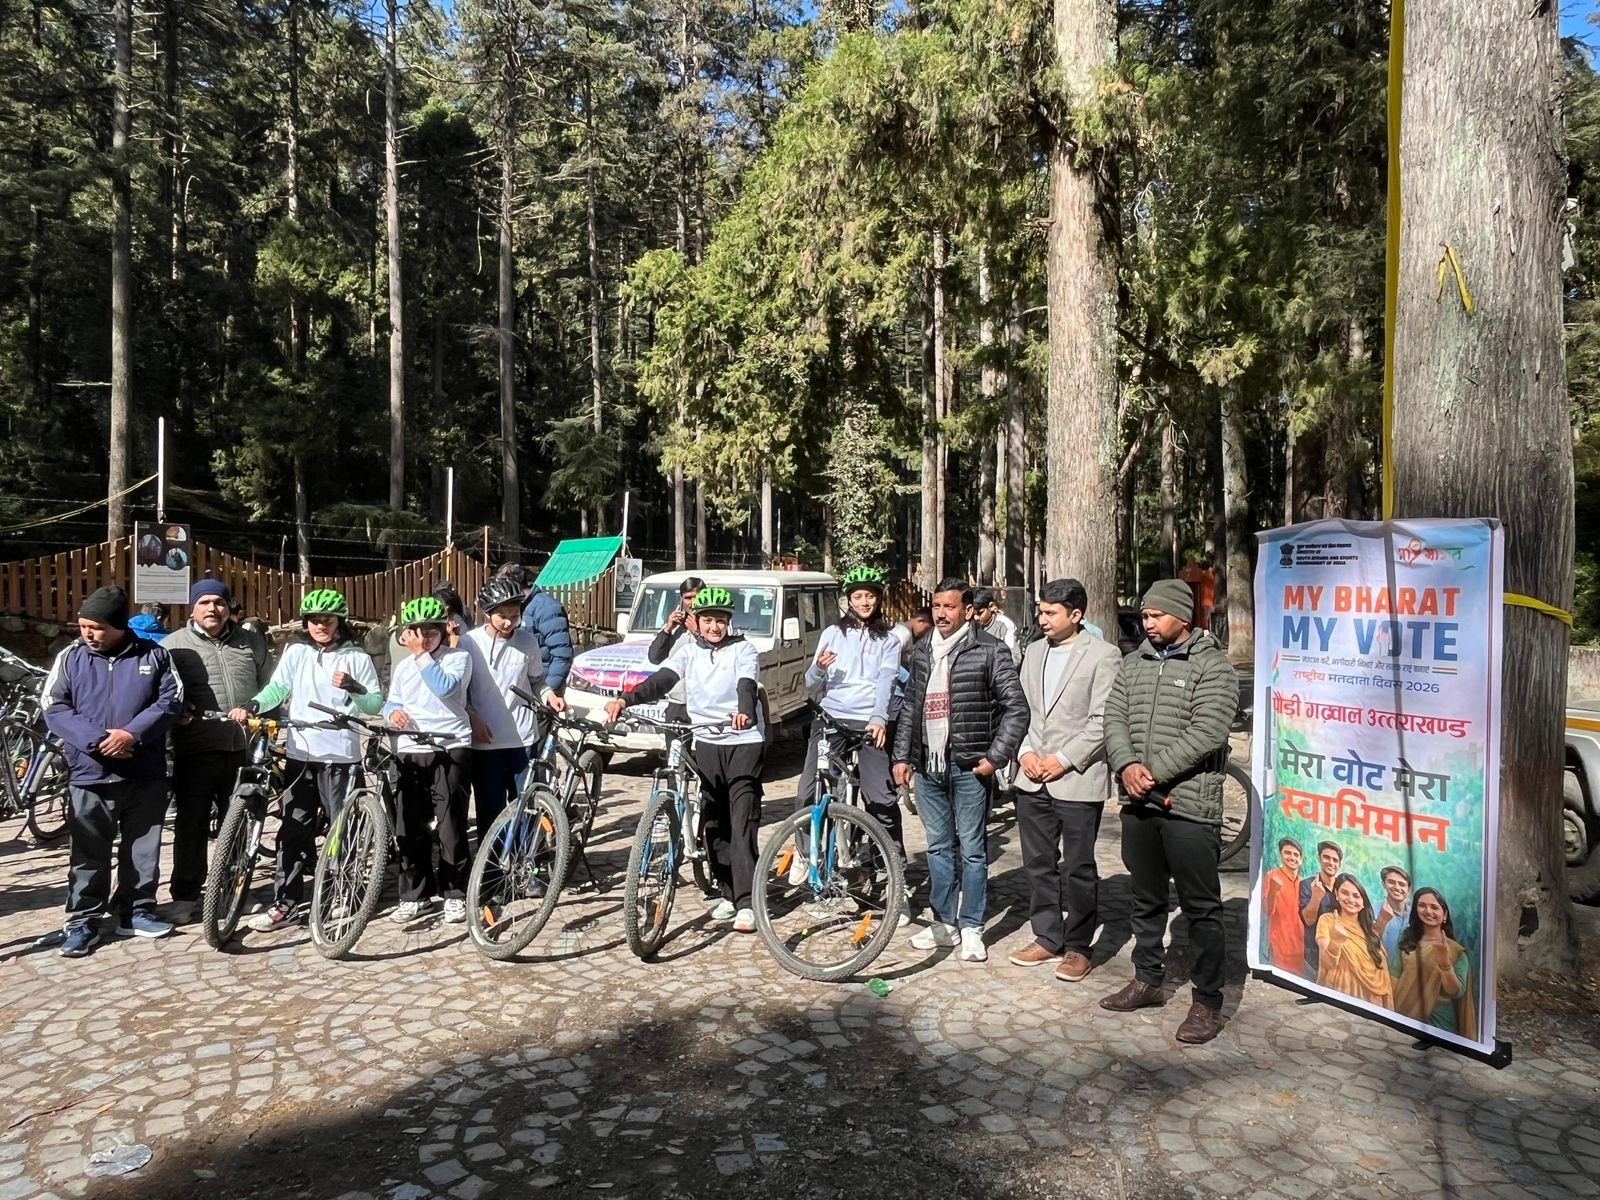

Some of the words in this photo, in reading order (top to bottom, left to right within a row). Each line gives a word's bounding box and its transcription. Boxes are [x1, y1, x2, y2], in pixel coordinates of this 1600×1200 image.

[1283, 585, 1324, 611] MY
[1334, 586, 1461, 616] BHARAT
[1282, 615, 1338, 651] MY
[1353, 619, 1459, 662] VOTE
[1292, 669, 1325, 684] राष्ट्रीय
[1328, 673, 1370, 687] मतदाता
[1372, 675, 1402, 689] दिवस
[1405, 681, 1440, 693] 2026
[1272, 691, 1302, 717] पौड़ी
[1279, 739, 1325, 780] मेरा
[1331, 749, 1386, 791] वोट
[1392, 757, 1451, 802] मेरा
[1279, 786, 1450, 853] स्वाभिमान
